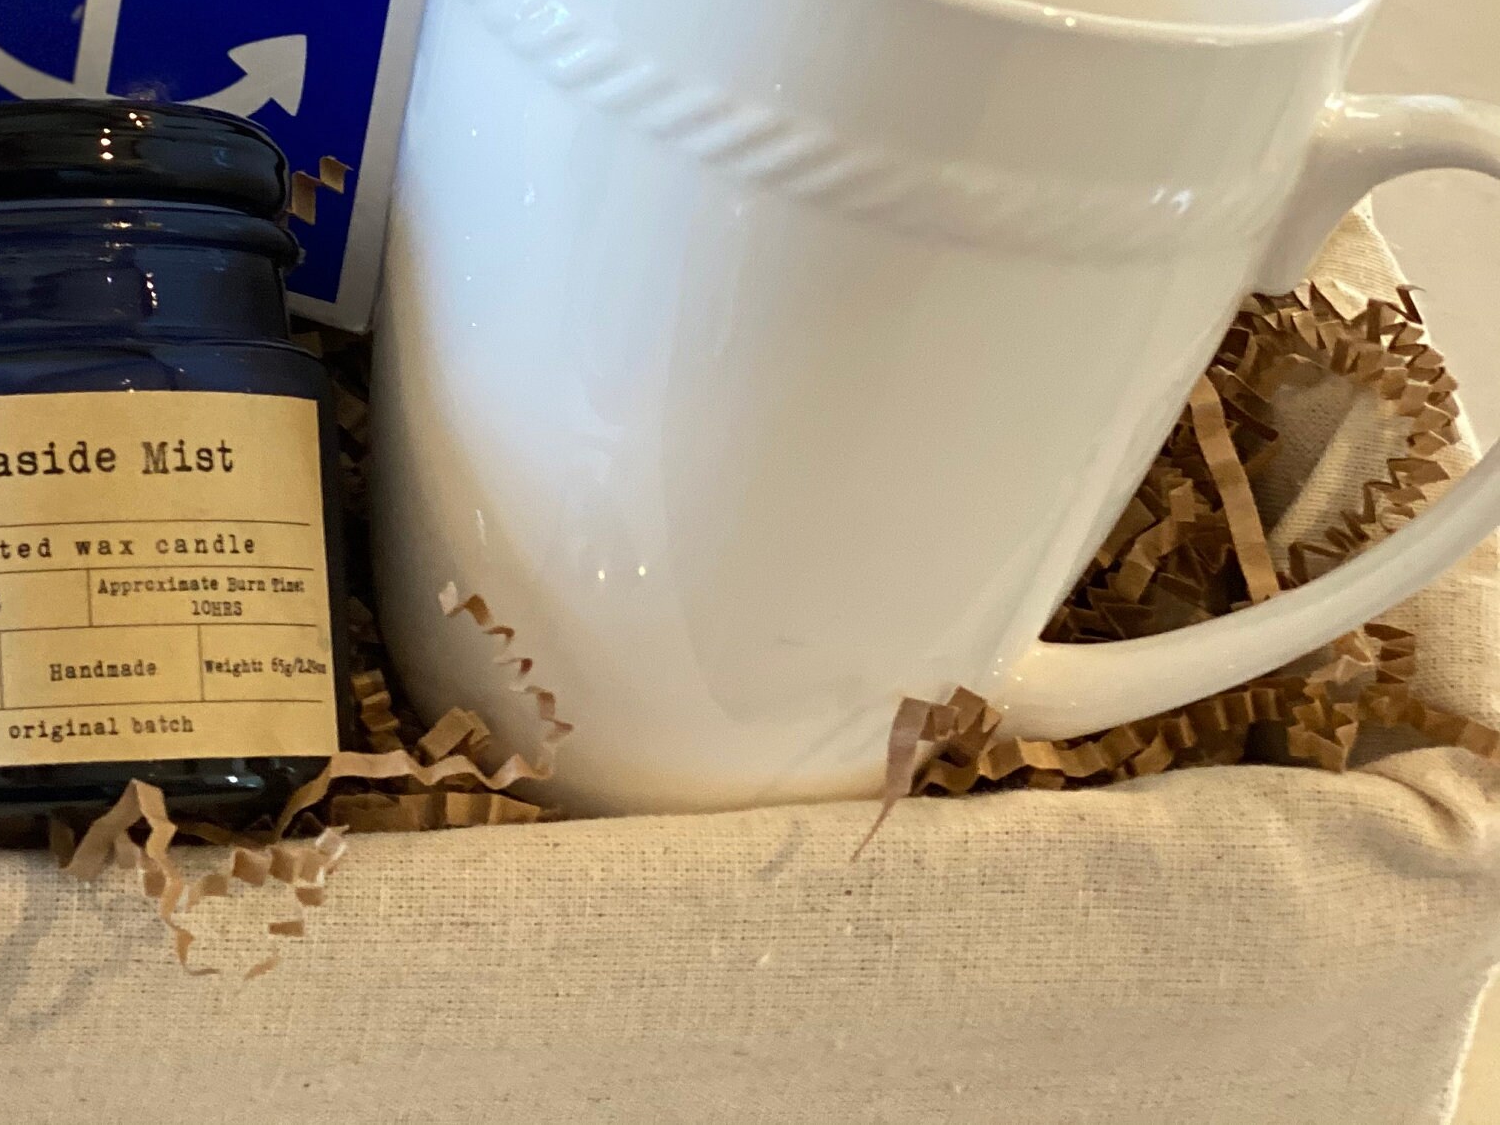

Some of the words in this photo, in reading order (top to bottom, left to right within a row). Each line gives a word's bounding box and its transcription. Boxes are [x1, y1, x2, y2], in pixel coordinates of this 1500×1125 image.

[142, 439, 234, 476] Mist
[75, 540, 134, 559] wax
[156, 534, 256, 557] candle
[98, 577, 219, 596] Approximate
[227, 576, 266, 592] Burn
[49, 659, 157, 681] Handmade
[8, 716, 118, 744] original
[132, 714, 194, 735] batch
